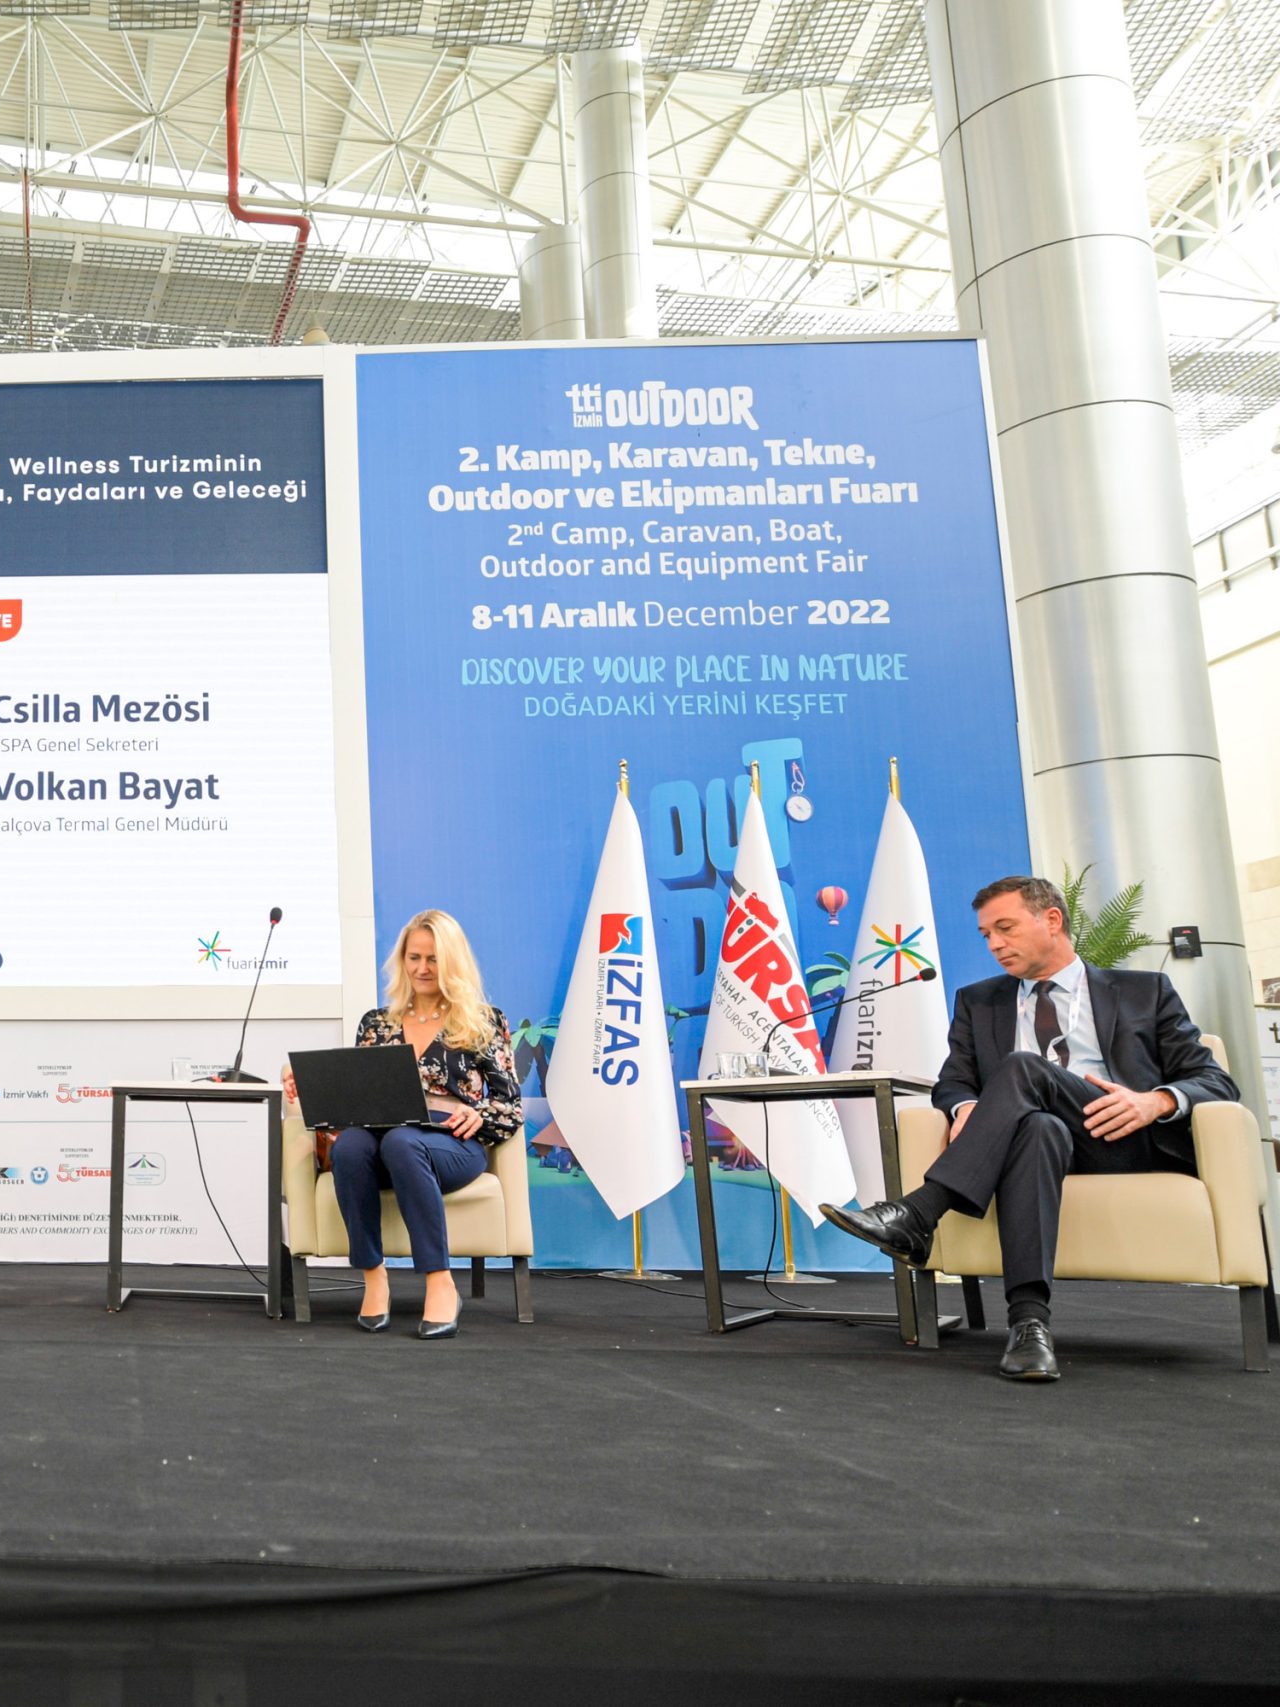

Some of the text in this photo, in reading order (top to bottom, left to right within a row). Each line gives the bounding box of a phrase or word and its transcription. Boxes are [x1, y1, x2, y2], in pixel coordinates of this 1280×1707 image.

[573, 413, 603, 428] İZMİR
[606, 381, 760, 430] OUTDOOR
[9, 456, 120, 475] Wellness
[129, 454, 262, 473] Turizminin
[459, 437, 876, 477] 2. Kamp, Karavan, Tekne,
[23, 482, 145, 506] Faydaları
[155, 485, 183, 501] ve
[193, 480, 307, 503] Geleceği
[428, 476, 919, 514] Outdoor ve Ekipmanları Fuarı
[507, 518, 843, 550] 2nd Camp, Caravan, Boat,
[480, 549, 868, 580] Outdoor and Equipment Fair
[472, 599, 890, 630] 8-11 Aralık December 2022
[461, 652, 909, 688] DISCOVER YOUR PLACE IN NATURE
[92, 692, 209, 723] Mezösi
[524, 690, 848, 720] DOĞADAKİ YERİNİ KEŞFET
[37, 737, 81, 752] Genel
[86, 737, 159, 752] Sekreteri
[119, 771, 220, 809] Bayat
[56, 817, 109, 832] Termal
[115, 816, 160, 832] Genel
[165, 816, 228, 832] Müdürü
[227, 957, 289, 969] fuarizmir
[596, 983, 605, 1010] FUARI
[723, 1004, 760, 1044] TURKISH
[856, 979, 883, 1071] fuarizm
[3, 1088, 26, 1099] İzmir
[27, 1088, 49, 1099] Vakfı
[18, 1212, 81, 1222] DENETİMİNDE
[19, 1226, 38, 1235] AND
[39, 1226, 91, 1235] COMMODITY
[145, 1226, 156, 1235] OF
